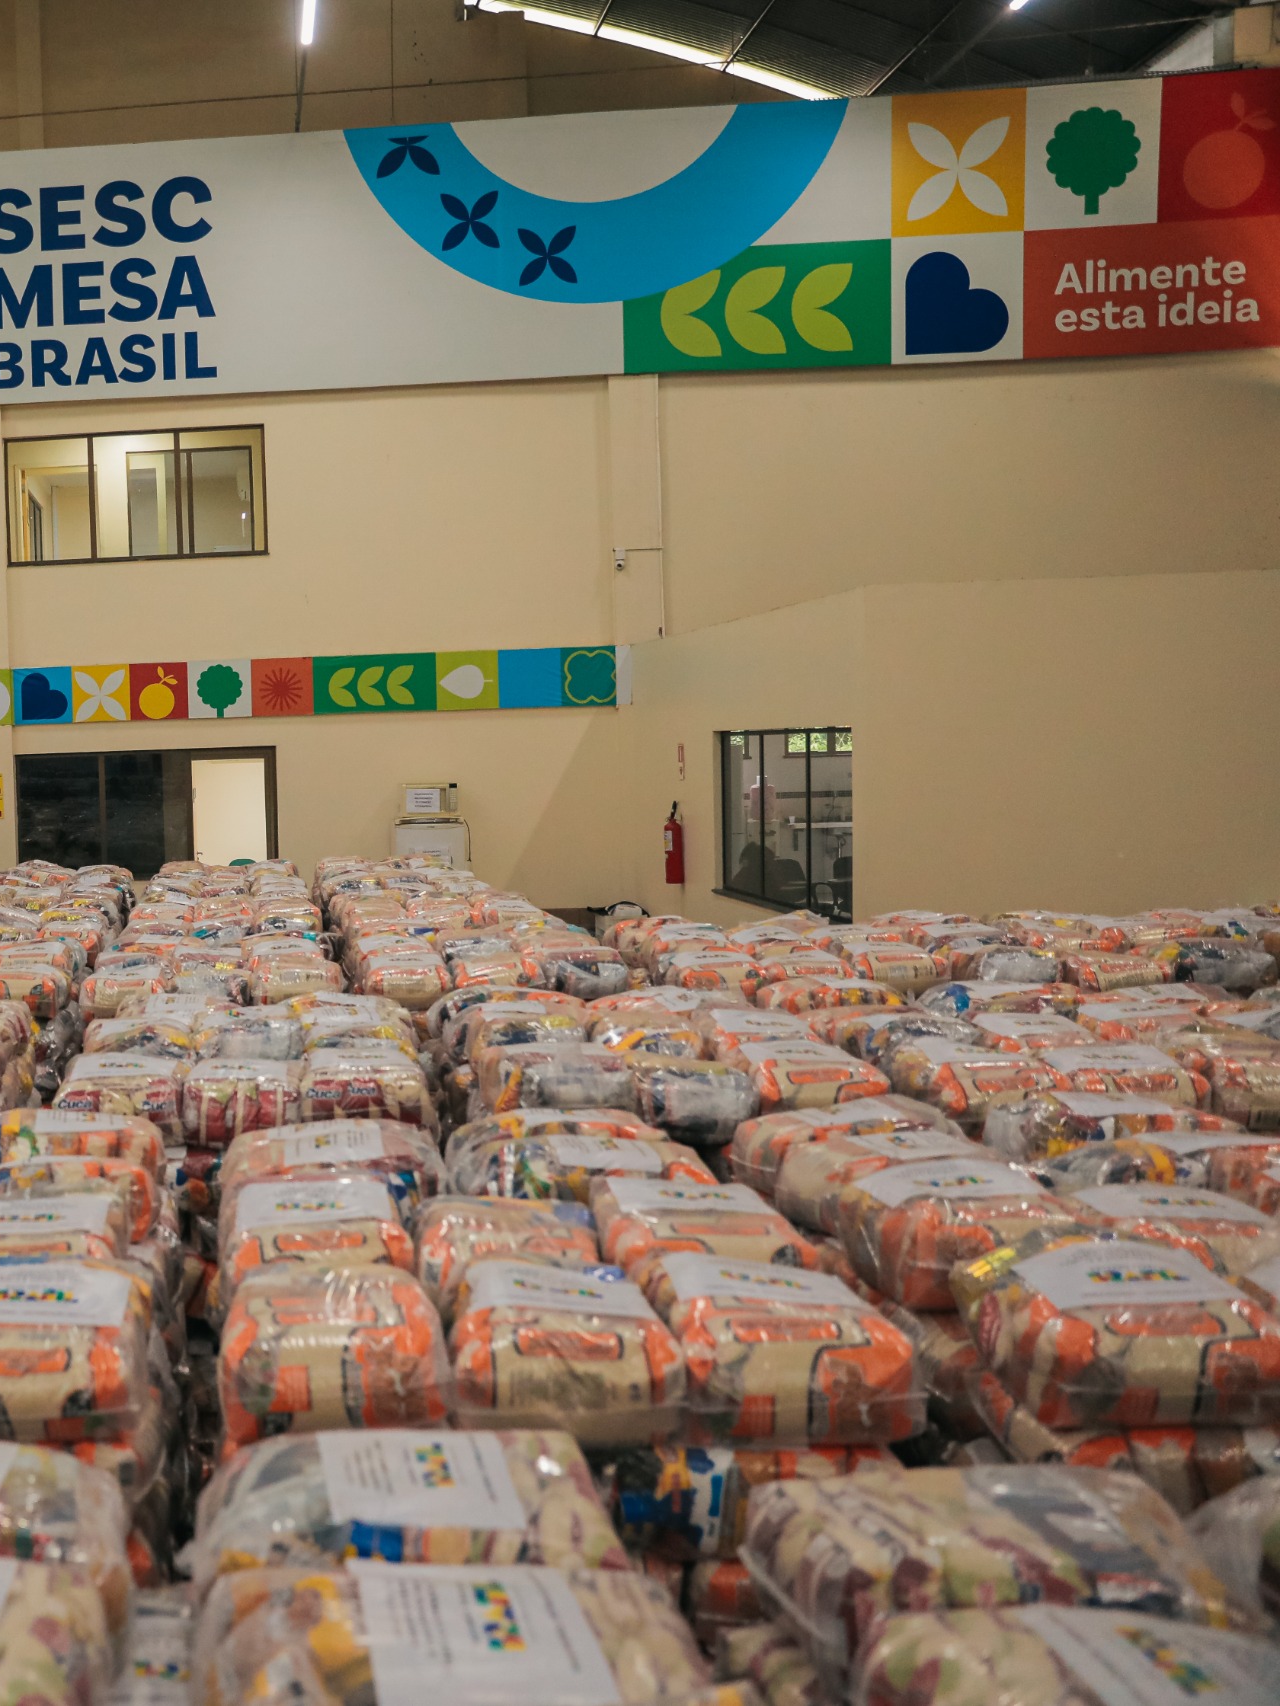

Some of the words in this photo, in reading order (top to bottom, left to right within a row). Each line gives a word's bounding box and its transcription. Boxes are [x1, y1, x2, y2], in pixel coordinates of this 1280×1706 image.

[1054, 256, 1246, 295] Alimente
[1054, 300, 1146, 332] esta
[1158, 289, 1260, 327] ideia
[58, 1099, 92, 1109] Cuca
